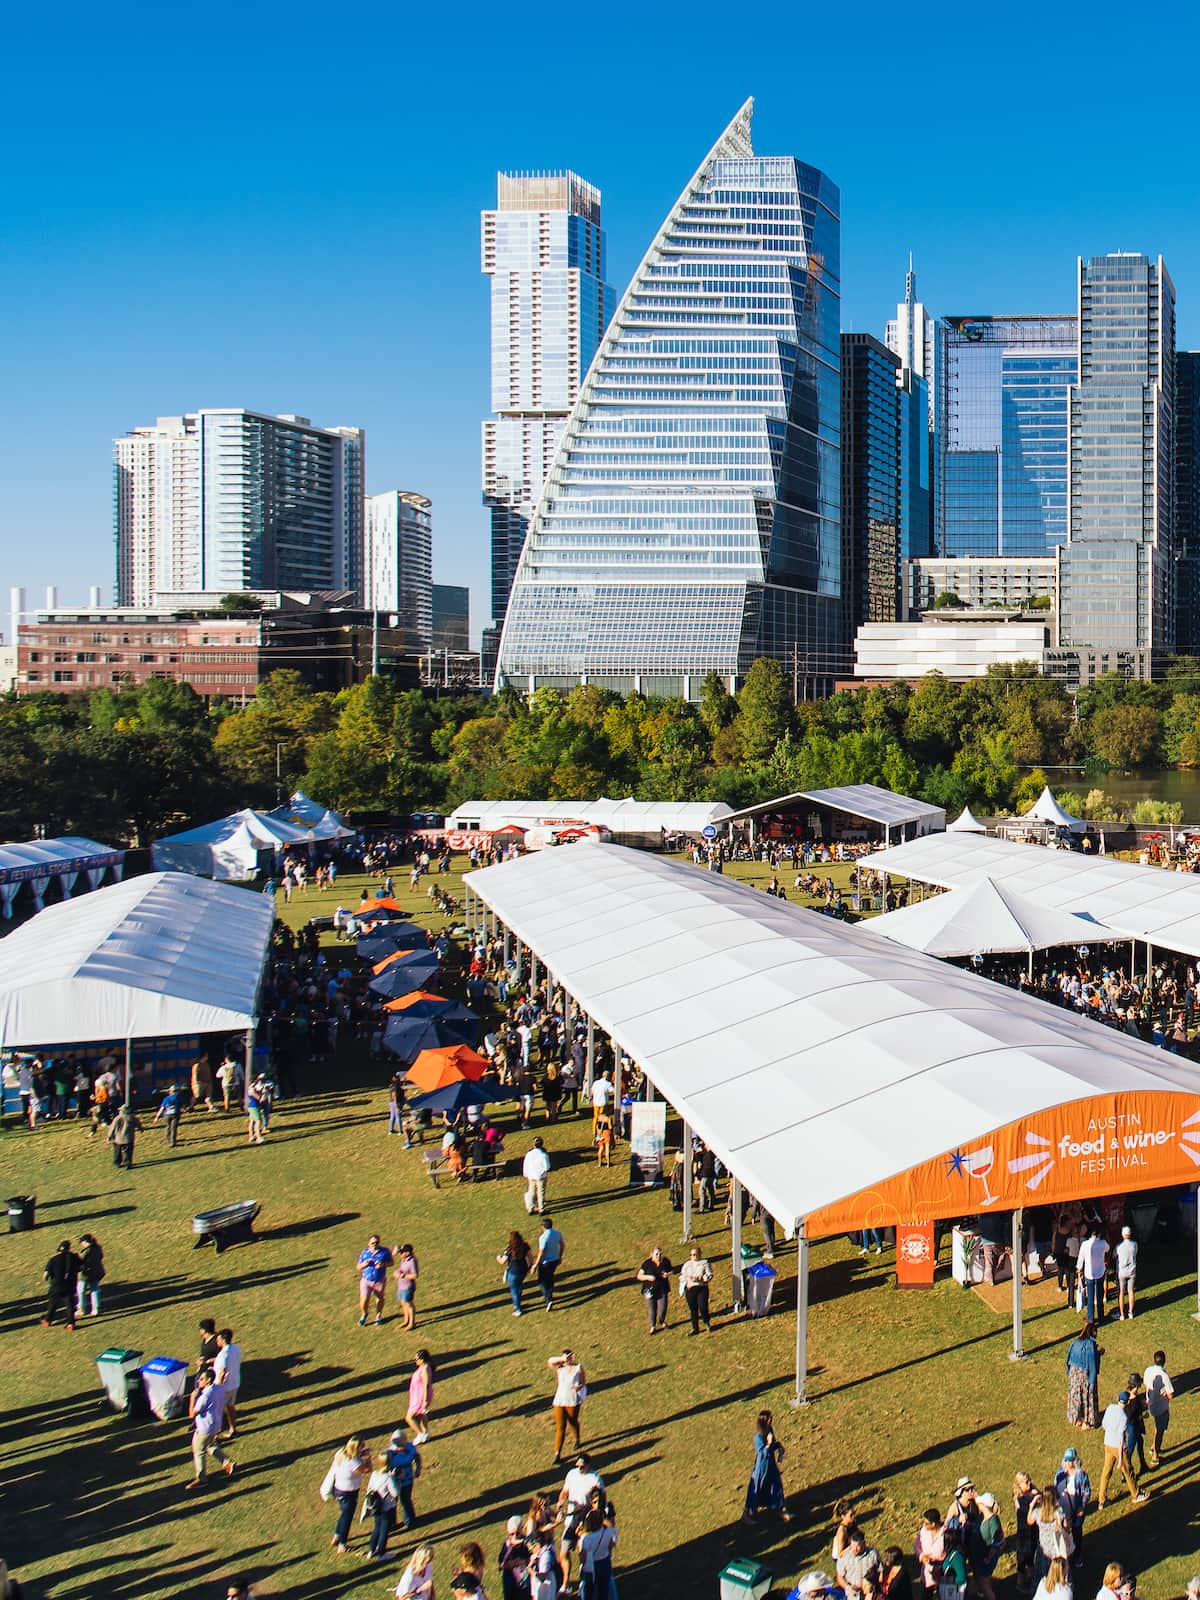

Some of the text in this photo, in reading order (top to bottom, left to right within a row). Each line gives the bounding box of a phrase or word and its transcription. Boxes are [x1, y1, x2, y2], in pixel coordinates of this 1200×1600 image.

[448, 834, 492, 851] EXIT
[1087, 1113, 1141, 1131] AUSTIN
[1058, 1130, 1176, 1158] food & wine
[1080, 1153, 1148, 1173] FESTIVAL
